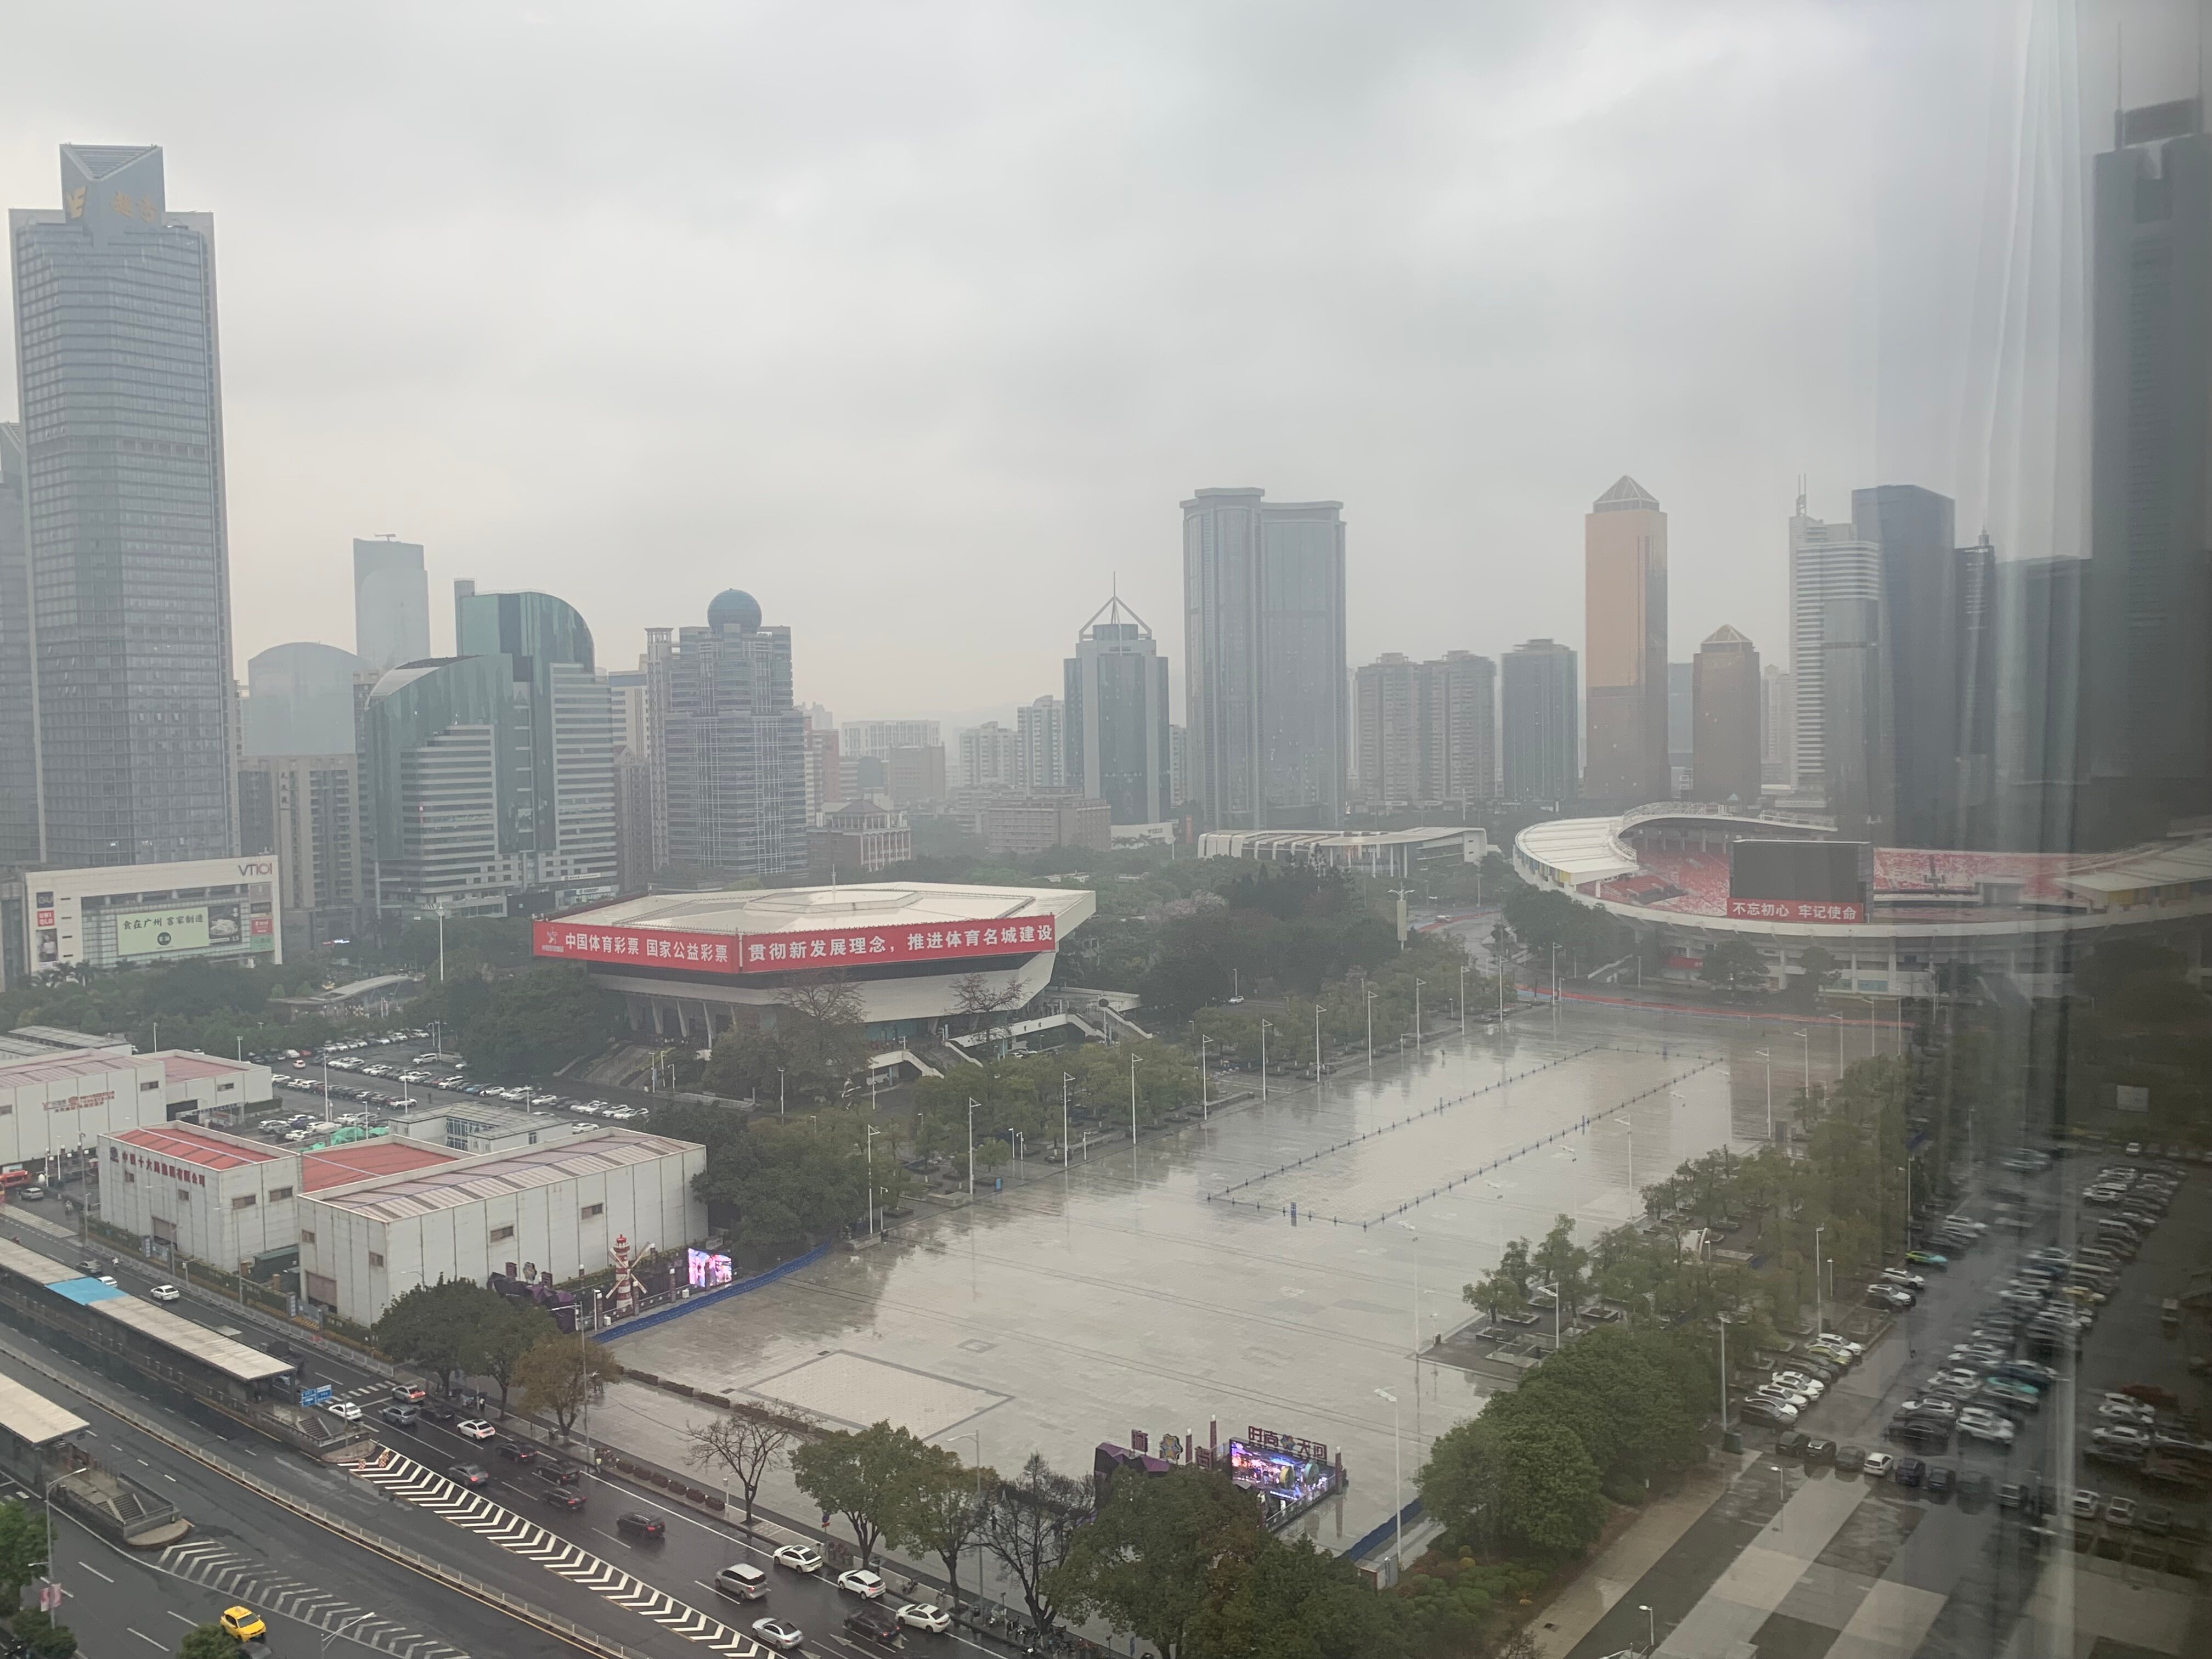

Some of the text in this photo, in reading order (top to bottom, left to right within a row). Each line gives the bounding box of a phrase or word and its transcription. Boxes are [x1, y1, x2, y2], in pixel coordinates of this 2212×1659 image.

[238, 863, 272, 876] VT101
[38, 896, 53, 904] GU
[1733, 902, 1857, 921] 不忘初心 牢记使命
[123, 917, 162, 930] 食在广州
[566, 932, 729, 963] 中国体育彩票 国家公益彩票
